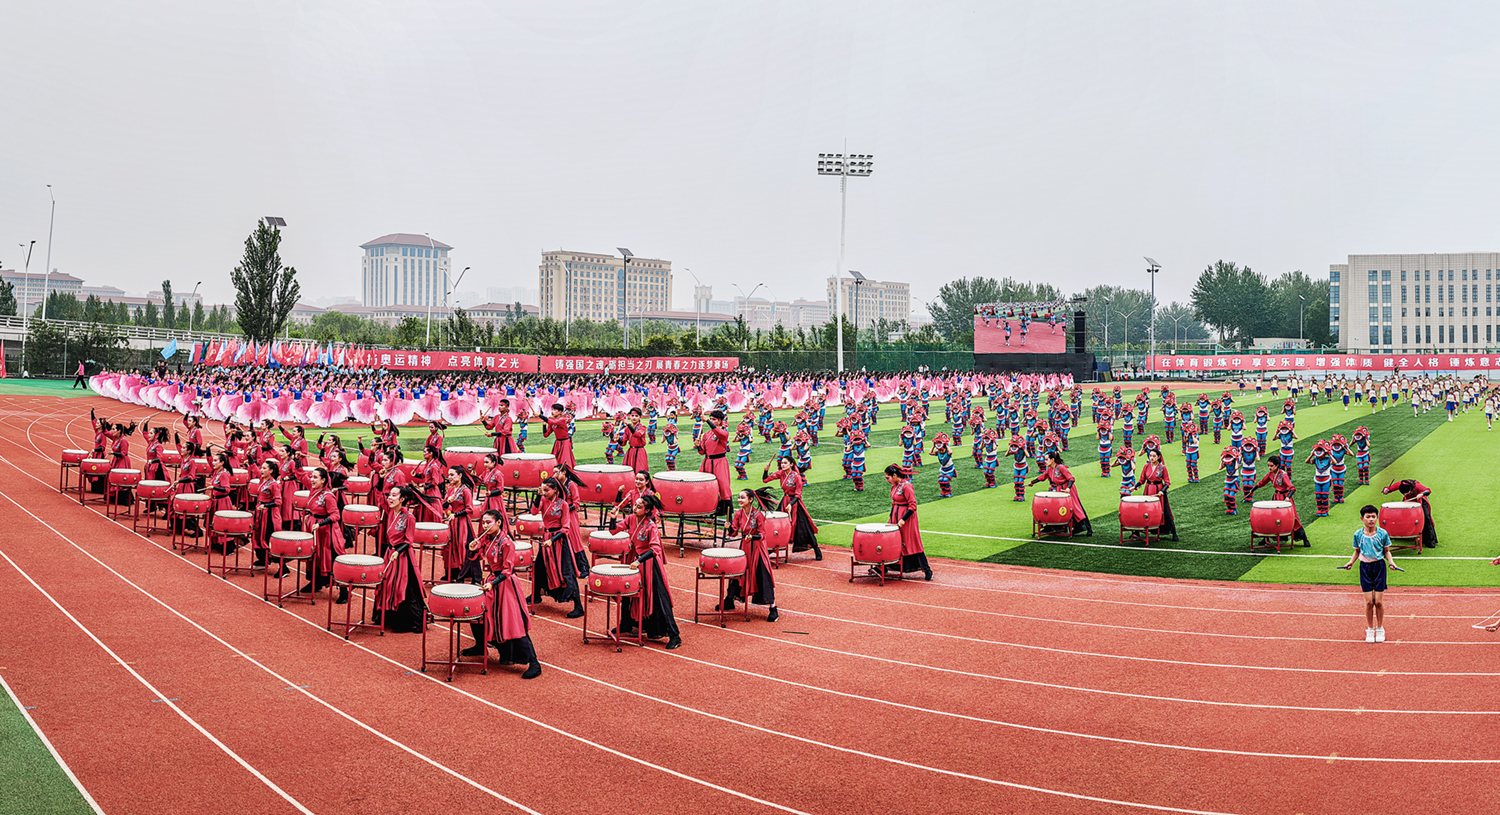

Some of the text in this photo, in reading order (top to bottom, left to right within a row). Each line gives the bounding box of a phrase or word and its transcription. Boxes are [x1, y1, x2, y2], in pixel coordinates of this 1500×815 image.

[353, 354, 520, 368] 扬奥运精神 点亮体育之光
[555, 359, 604, 370] 铸强国之魂
[1161, 358, 1242, 367] 在体育锻炼中
[1252, 357, 1306, 367] 享受乐趣
[1316, 357, 1373, 367] 增强体质
[1383, 357, 1439, 367] 健全人格
